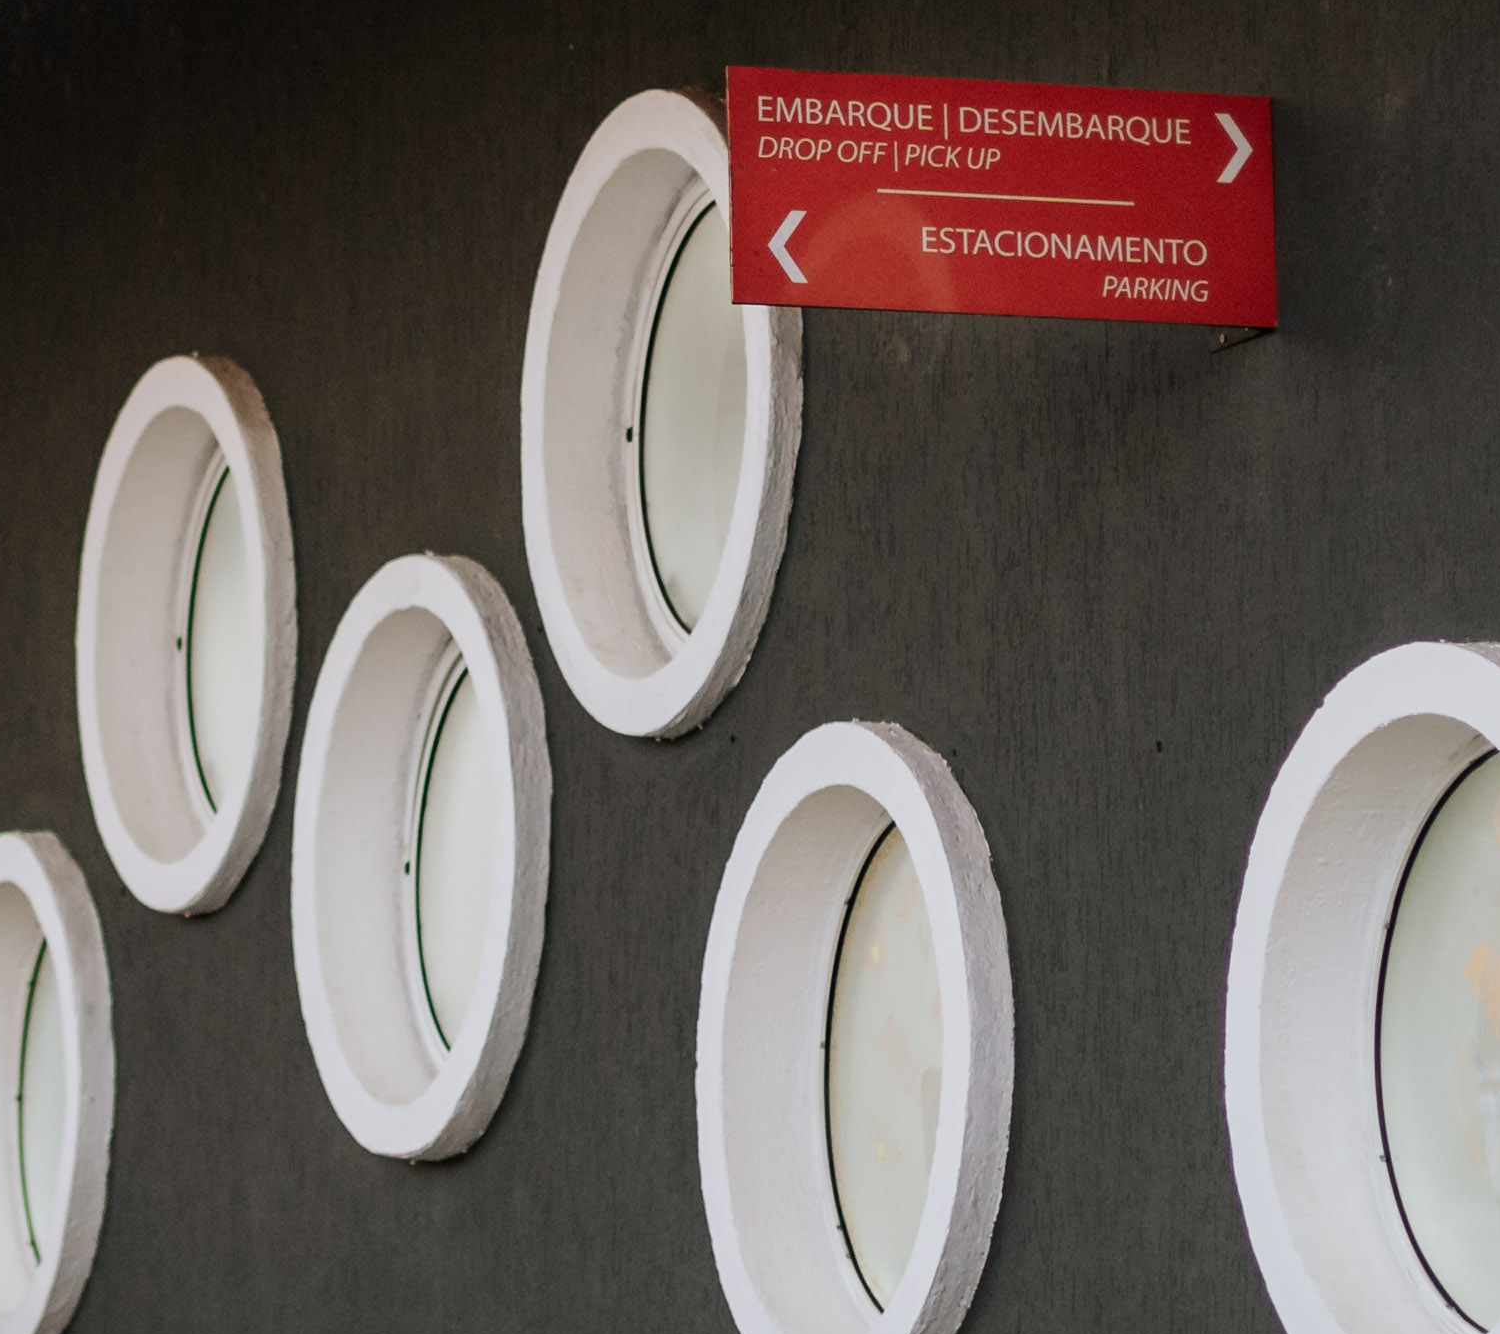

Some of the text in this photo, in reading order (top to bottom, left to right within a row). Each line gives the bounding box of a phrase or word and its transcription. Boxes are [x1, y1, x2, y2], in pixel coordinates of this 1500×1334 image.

[757, 95, 934, 132] EMBARQUE
[958, 106, 1192, 146] DESEMBARQUE
[757, 135, 832, 161] DROP
[836, 140, 888, 164] OFF
[904, 144, 962, 168] PICK
[966, 147, 1001, 170] UP
[921, 226, 1208, 267] ESTACIONAMENTO
[1102, 275, 1209, 302] PARKING
